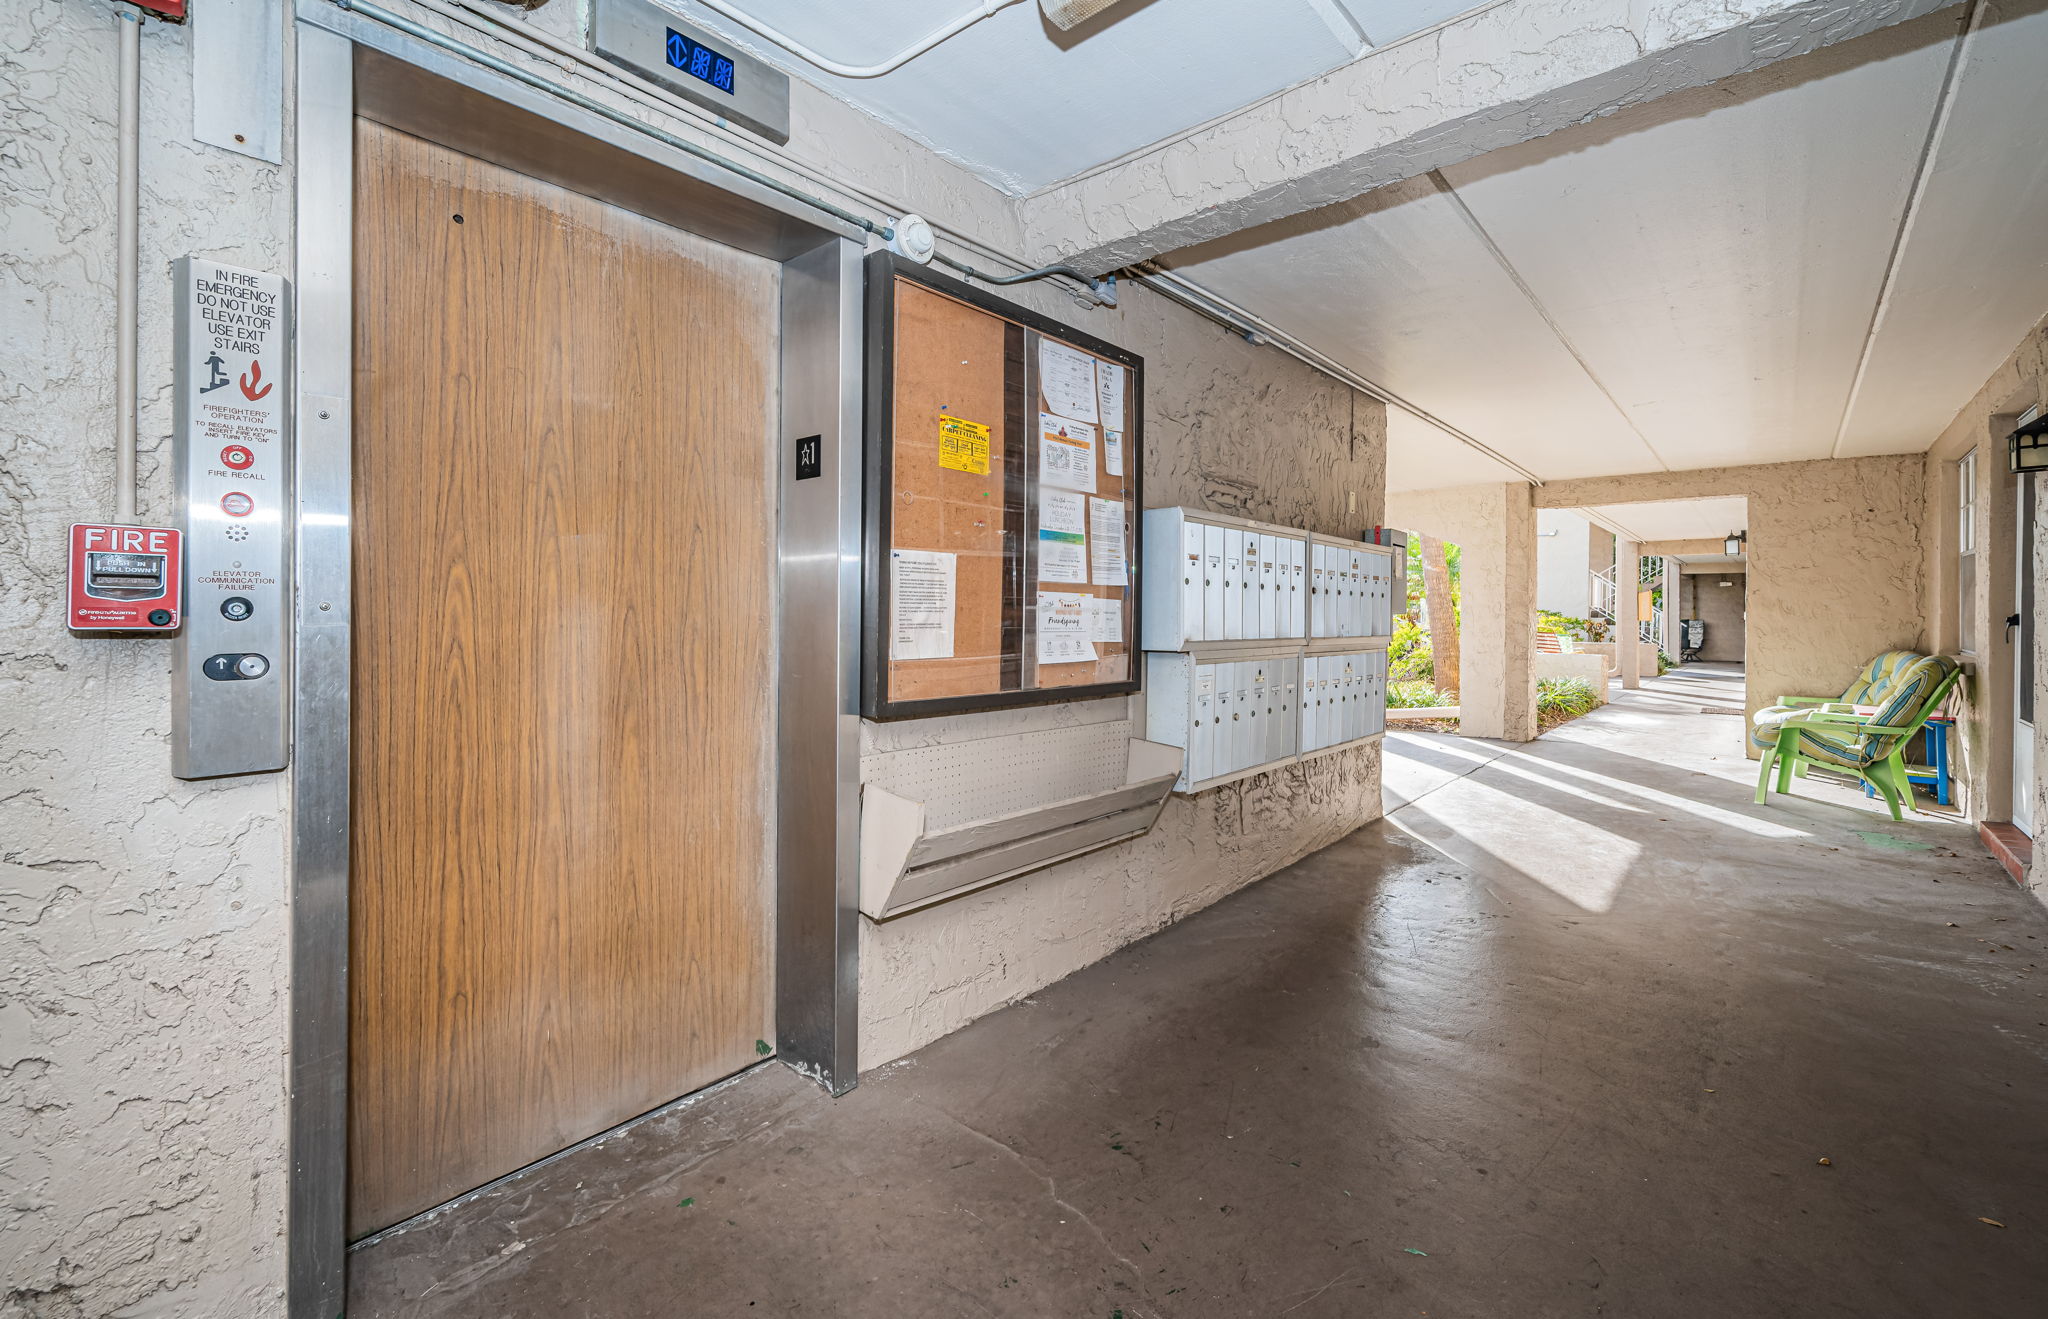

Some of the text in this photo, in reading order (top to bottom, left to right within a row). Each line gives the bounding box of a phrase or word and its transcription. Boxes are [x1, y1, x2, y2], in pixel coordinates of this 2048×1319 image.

[215, 269, 259, 289] IN FIRE
[196, 279, 276, 304] EMERGENCY
[197, 293, 276, 318] DO NOT USE
[202, 307, 271, 330] ELEVATOR
[208, 322, 265, 342] USE EXIT
[214, 337, 260, 355] STAIRS
[210, 412, 264, 424] OPERATION
[208, 422, 235, 430] RECALL
[237, 425, 278, 435] ELEVATORS
[810, 441, 815, 465] 1
[208, 469, 266, 480] FIRE RECALL
[85, 528, 169, 553] FIRE
[197, 577, 275, 585] COMMUNICATION
[212, 570, 261, 578] ELEVATOR
